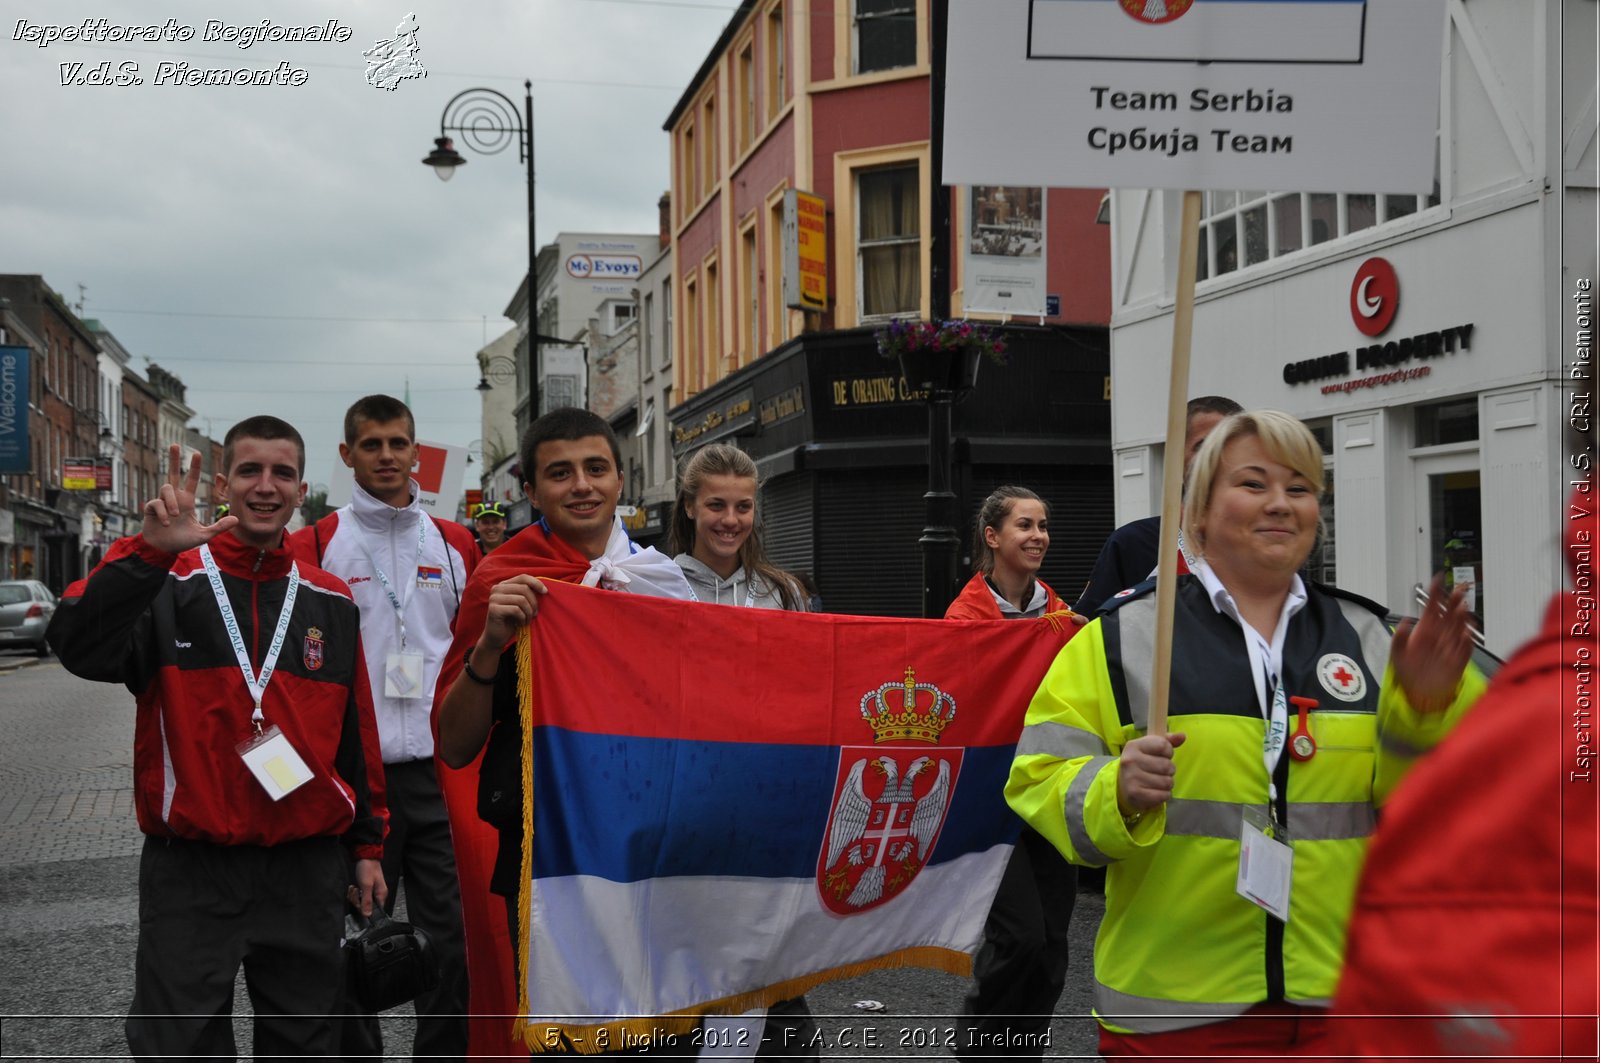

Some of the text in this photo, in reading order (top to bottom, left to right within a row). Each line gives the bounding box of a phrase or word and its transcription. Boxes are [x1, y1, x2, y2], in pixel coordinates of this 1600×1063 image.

[1090, 86, 1294, 113] Team Serbia
[1087, 126, 1199, 156] Србија
[570, 260, 639, 274] Mc Evoys
[1356, 323, 1475, 372] PROPERTY
[0, 355, 17, 435] Welcome
[202, 552, 216, 573] FACE
[209, 573, 225, 597] 2012
[220, 604, 245, 655] DUNDALK
[269, 632, 284, 657] FACE
[278, 607, 291, 633] 2012
